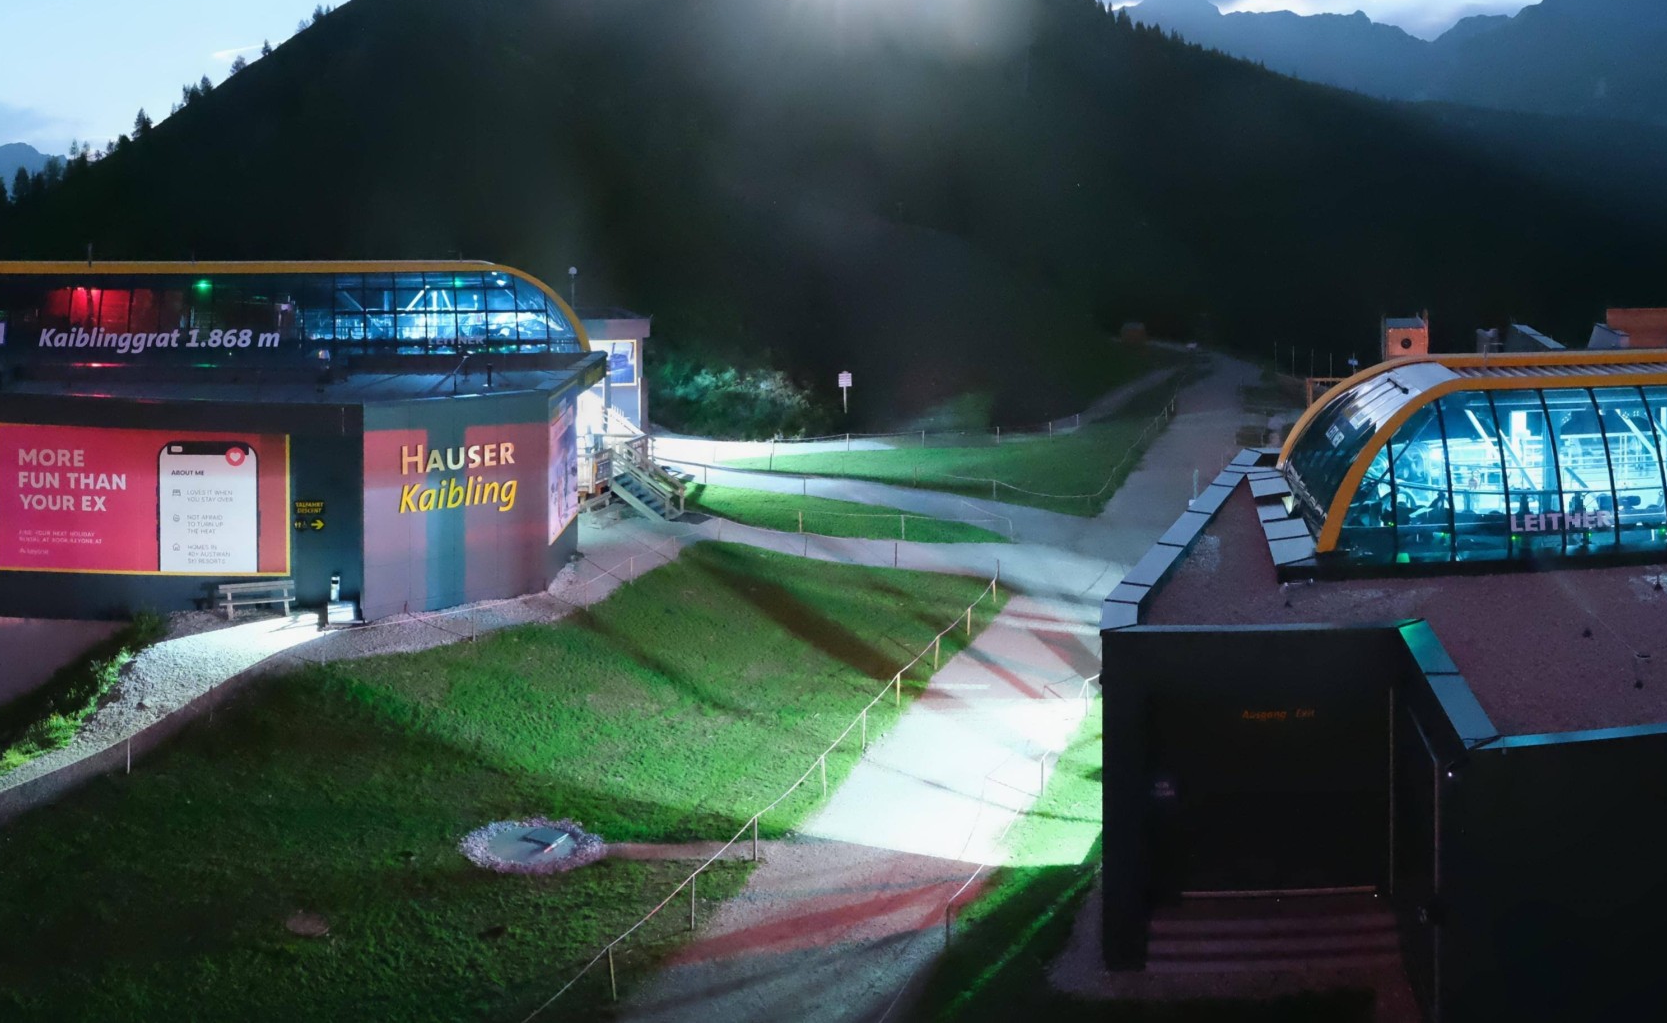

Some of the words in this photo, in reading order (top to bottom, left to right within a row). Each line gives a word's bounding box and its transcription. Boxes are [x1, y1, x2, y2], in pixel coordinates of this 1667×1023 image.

[38, 327, 181, 354] Kaiblinggrat
[185, 328, 252, 348] 1.868
[258, 332, 280, 348] m
[428, 335, 485, 345] LEITNER
[18, 448, 85, 467] MORE
[400, 442, 515, 475] HAUSER
[18, 471, 59, 489] FUN
[66, 472, 126, 490] THAN
[19, 494, 75, 511] YOUR
[81, 495, 107, 511] EX
[399, 477, 518, 514] Kaibling
[1511, 510, 1612, 532] LEITNER
[1241, 710, 1287, 721] Ausgang
[1296, 708, 1316, 718] Exit
